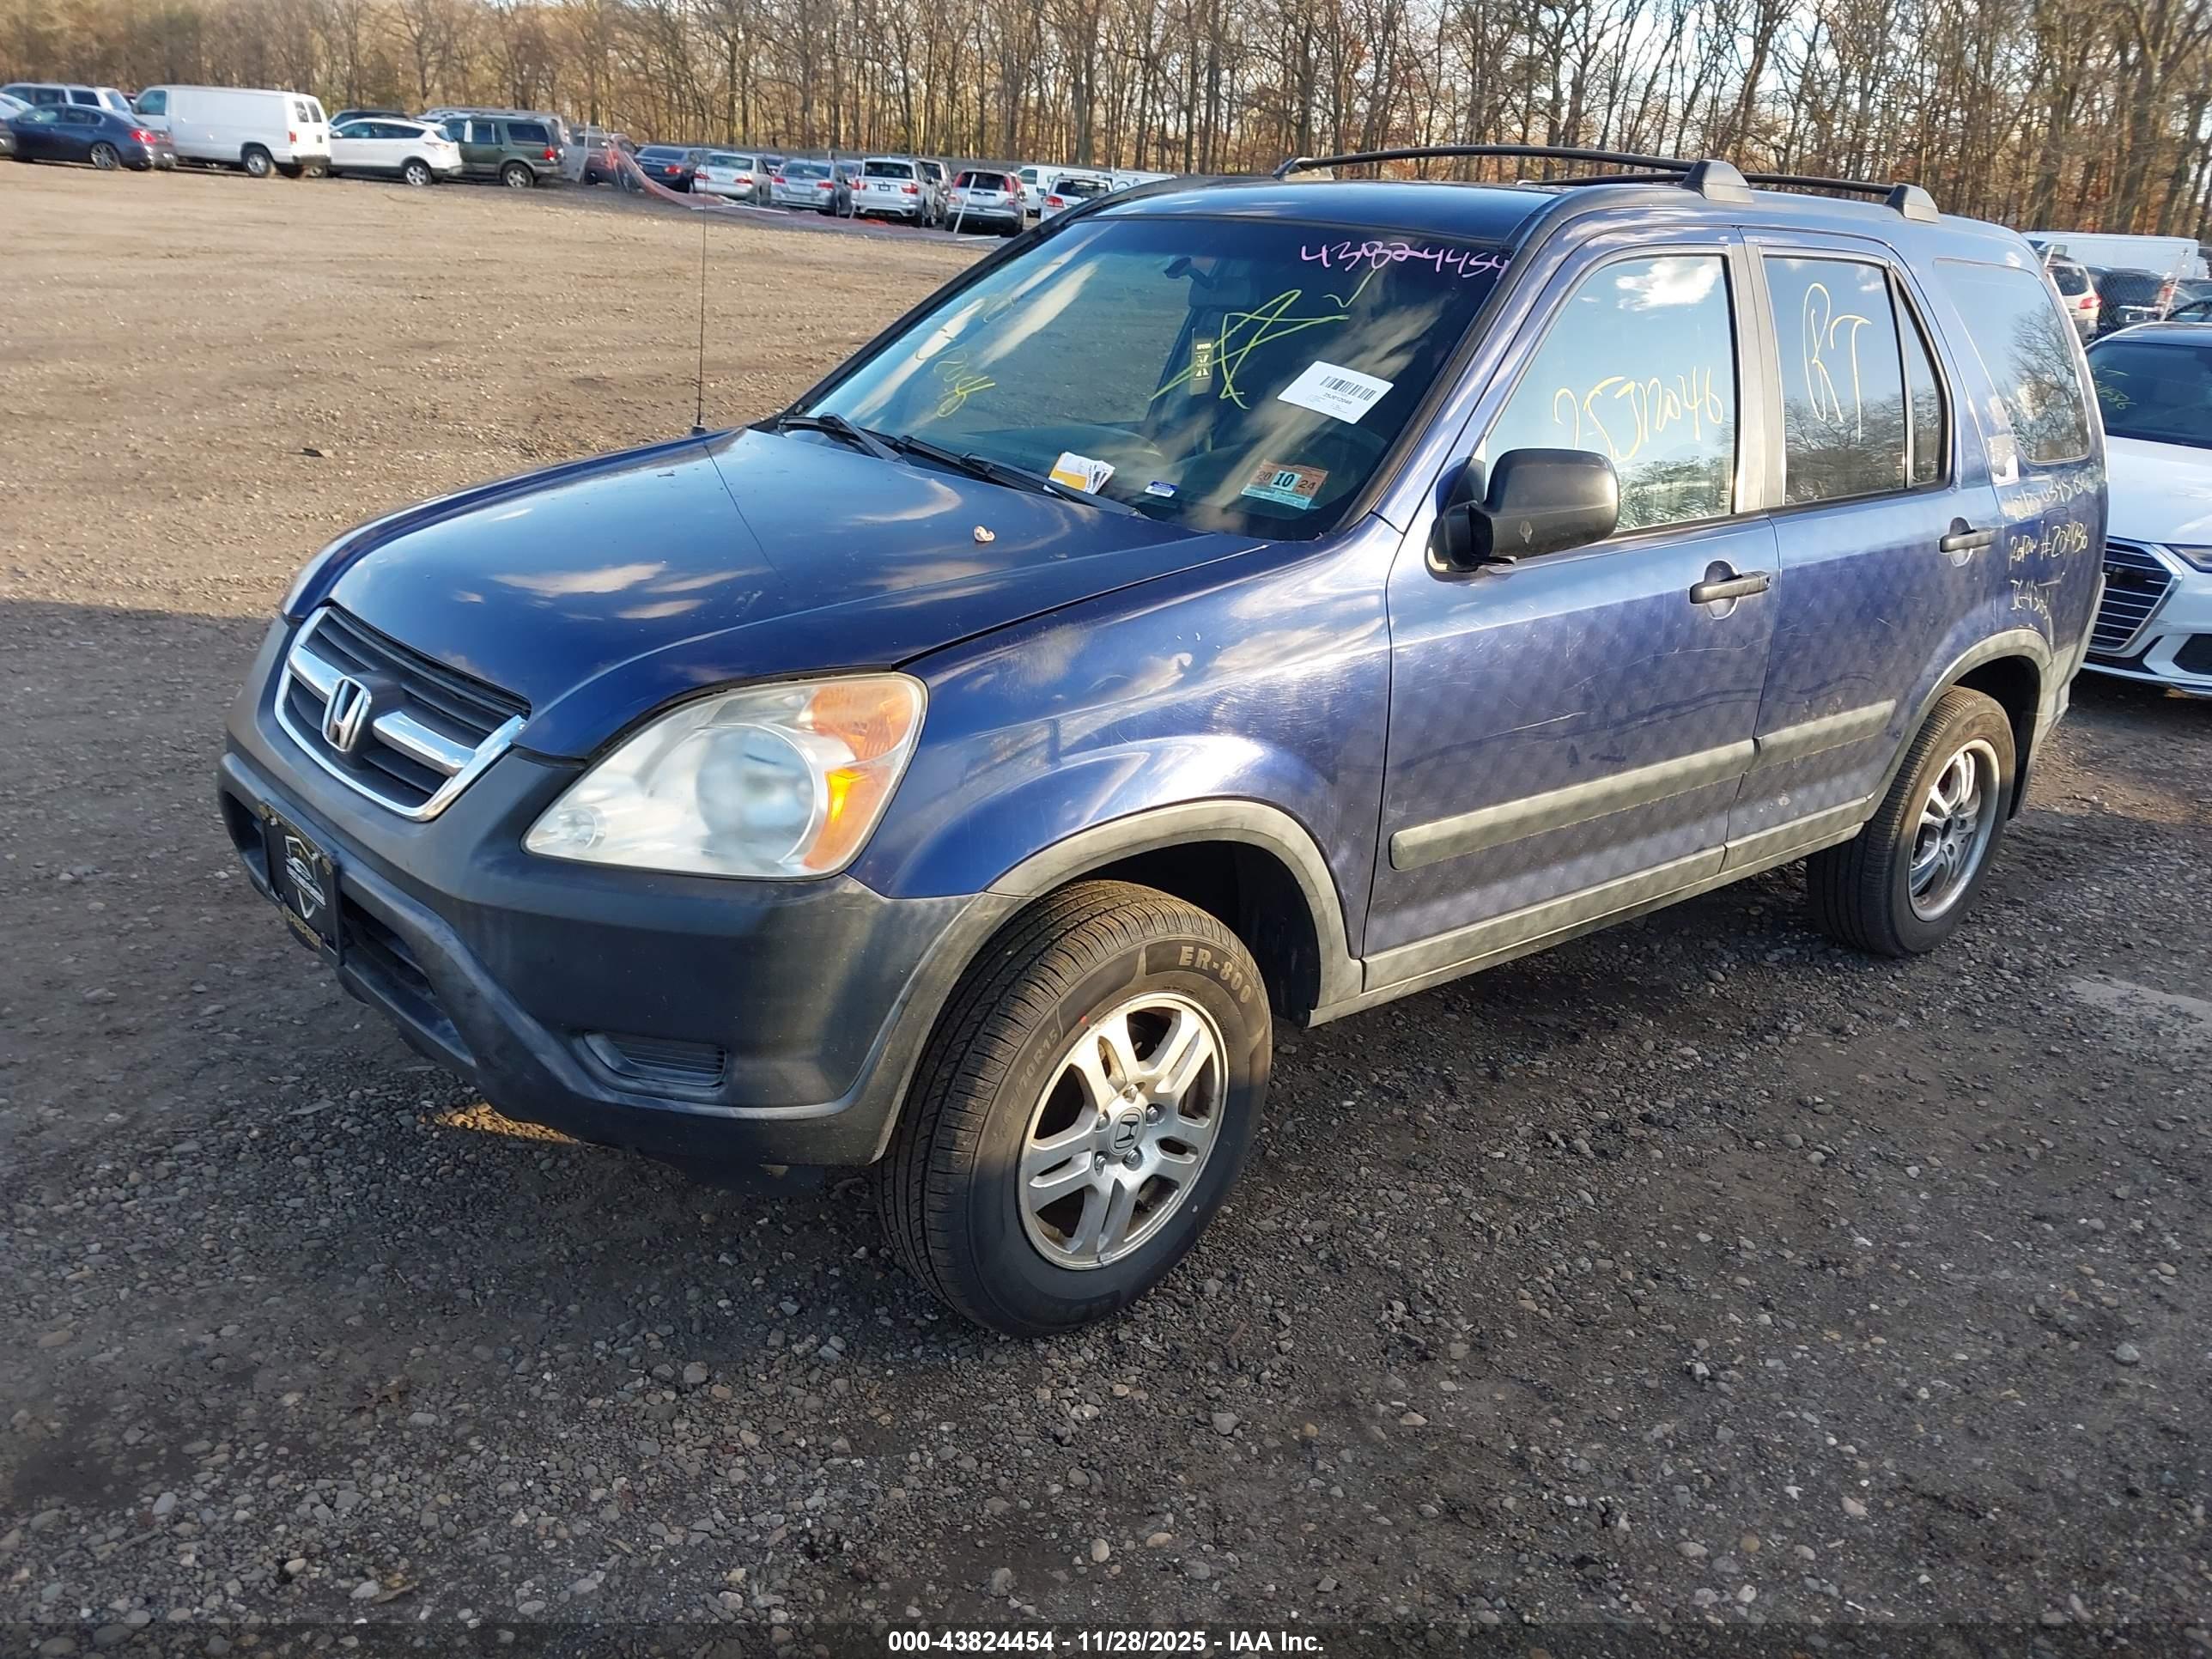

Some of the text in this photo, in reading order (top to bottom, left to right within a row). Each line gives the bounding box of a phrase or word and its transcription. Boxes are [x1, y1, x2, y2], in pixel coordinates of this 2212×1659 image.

[1300, 240, 1511, 280] 43824454
[1273, 471, 1294, 489] 10
[1298, 478, 1316, 490] 24
[1177, 945, 1253, 1005] ER-800
